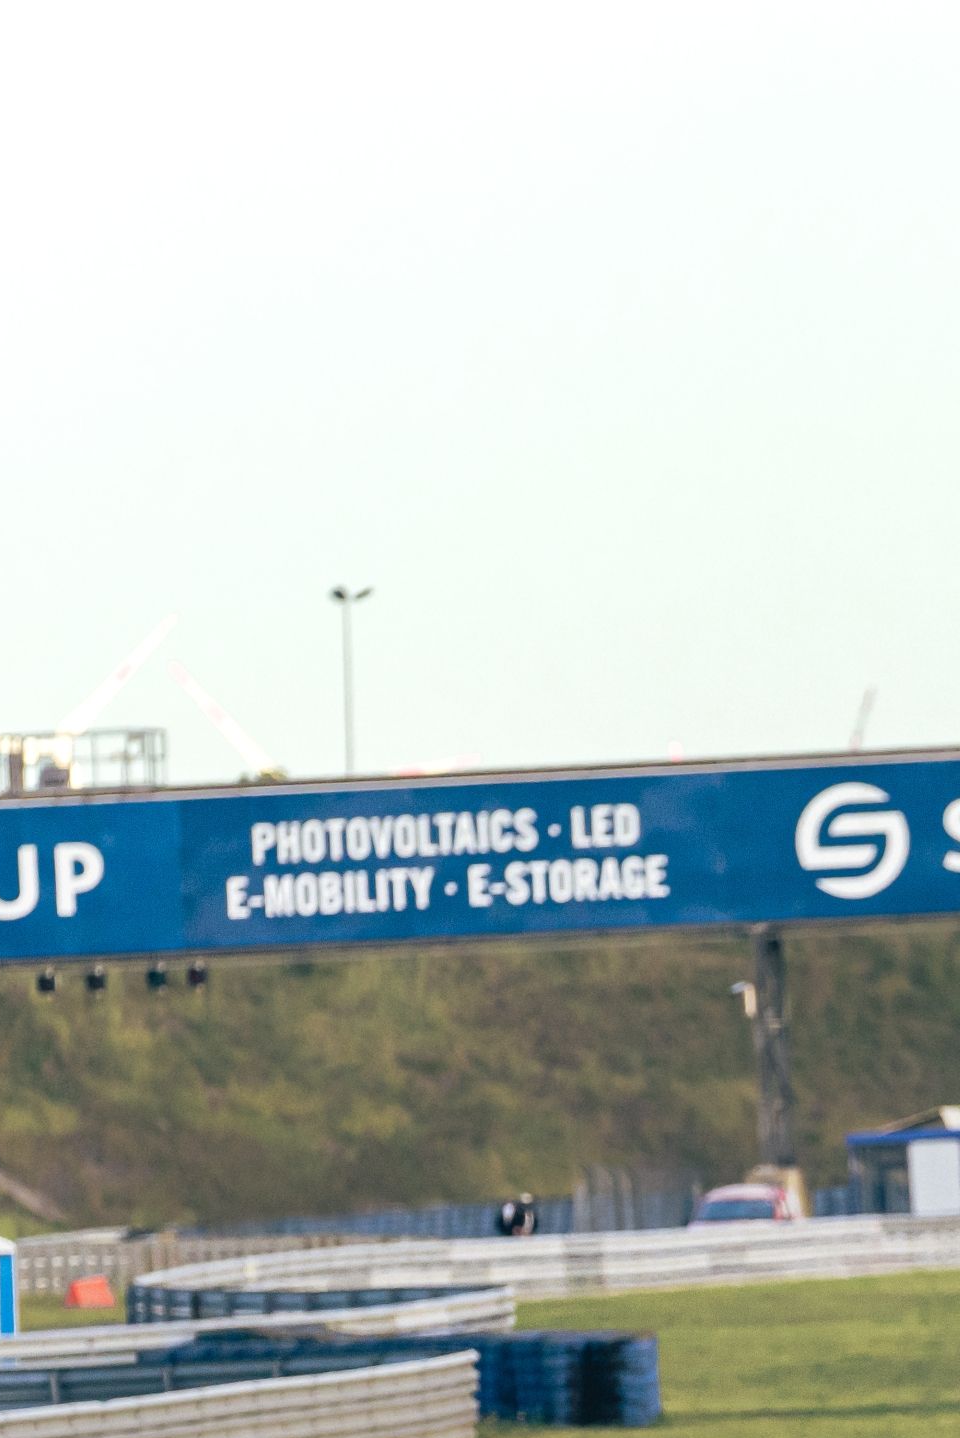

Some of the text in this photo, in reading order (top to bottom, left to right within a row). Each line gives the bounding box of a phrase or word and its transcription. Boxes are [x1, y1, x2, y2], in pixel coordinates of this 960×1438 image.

[251, 803, 641, 866] PHOTOVOLTAICS LED
[226, 854, 670, 920] E-MOBILITY E-STORAGE
